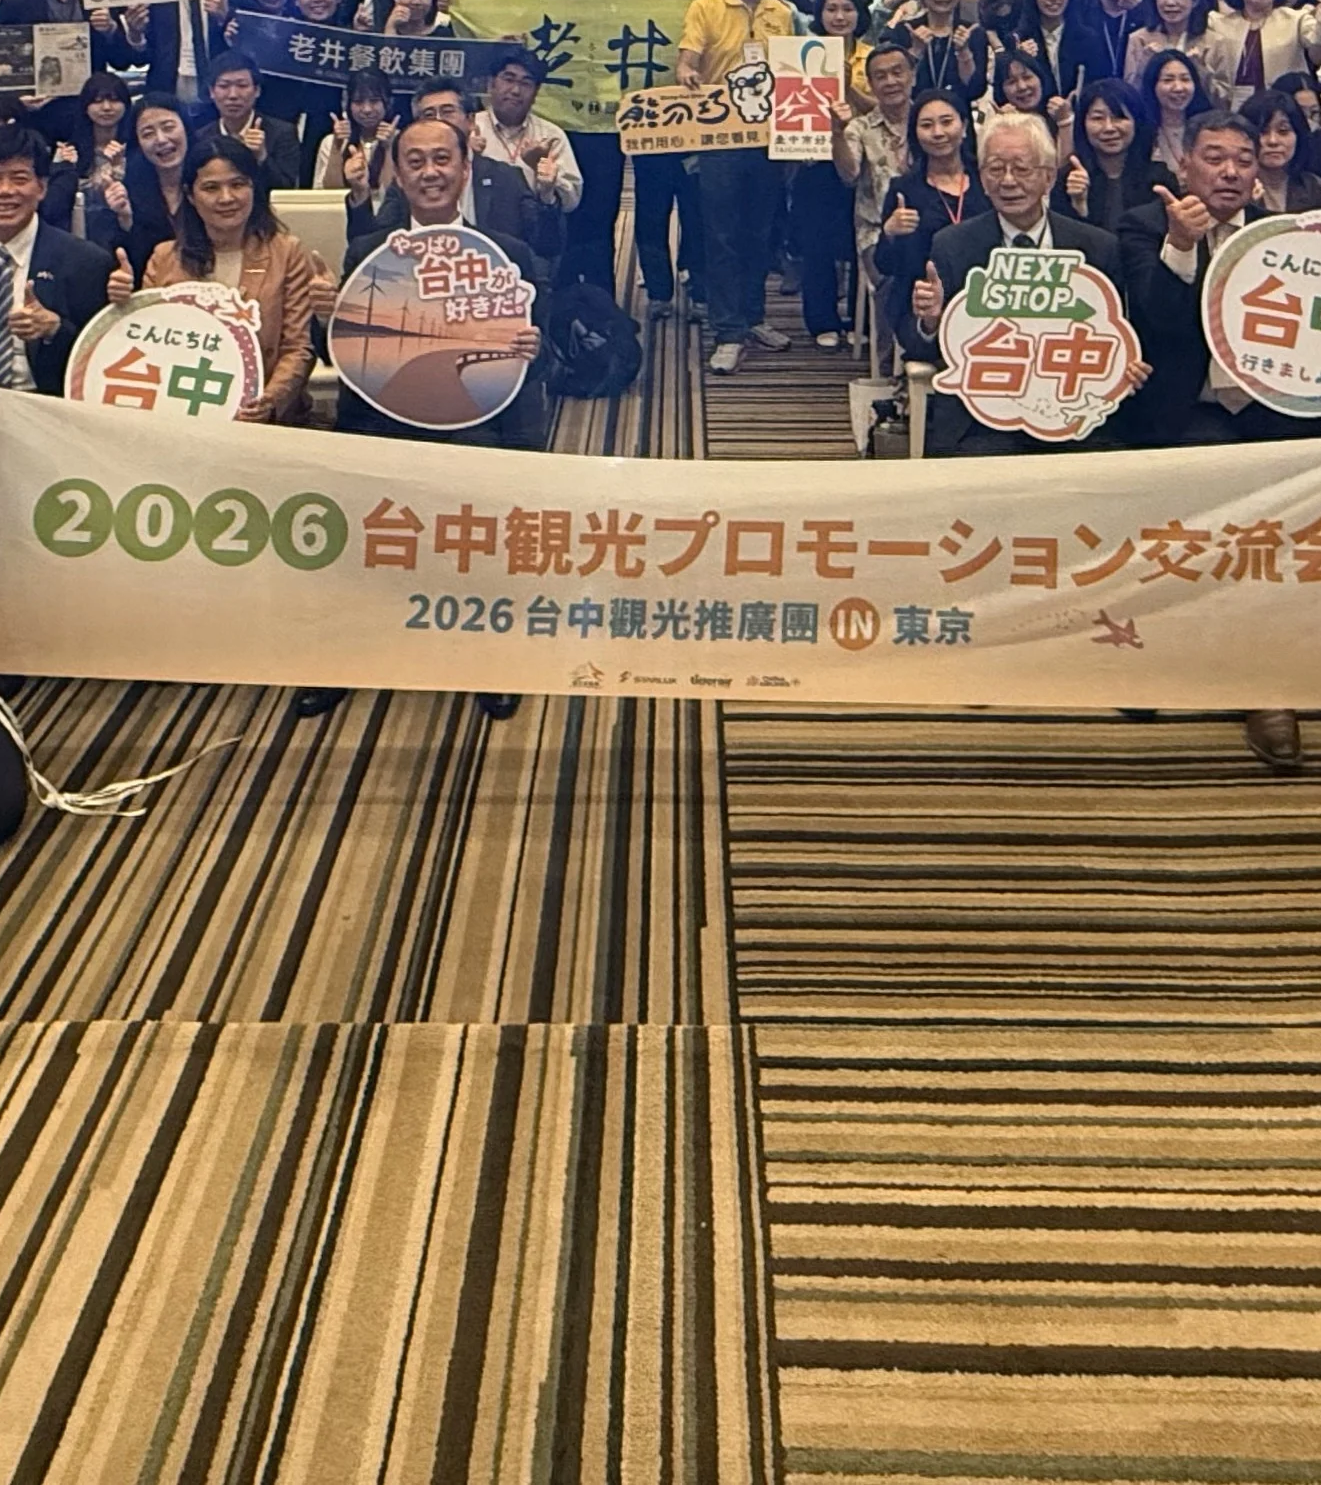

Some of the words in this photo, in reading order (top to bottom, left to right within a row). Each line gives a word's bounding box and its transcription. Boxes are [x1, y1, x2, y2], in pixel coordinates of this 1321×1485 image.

[288, 33, 465, 77] 老井餐飲集團
[775, 134, 832, 145] 臺中市好
[392, 234, 461, 256] やっぱり
[992, 253, 1080, 283] NEXT
[985, 284, 1073, 313] STOP
[126, 322, 223, 352] こんにちは
[968, 321, 1114, 397] 台中
[102, 346, 236, 416] 台中
[405, 592, 514, 635] 2026
[836, 609, 875, 642] IN
[893, 605, 976, 647] 東京
